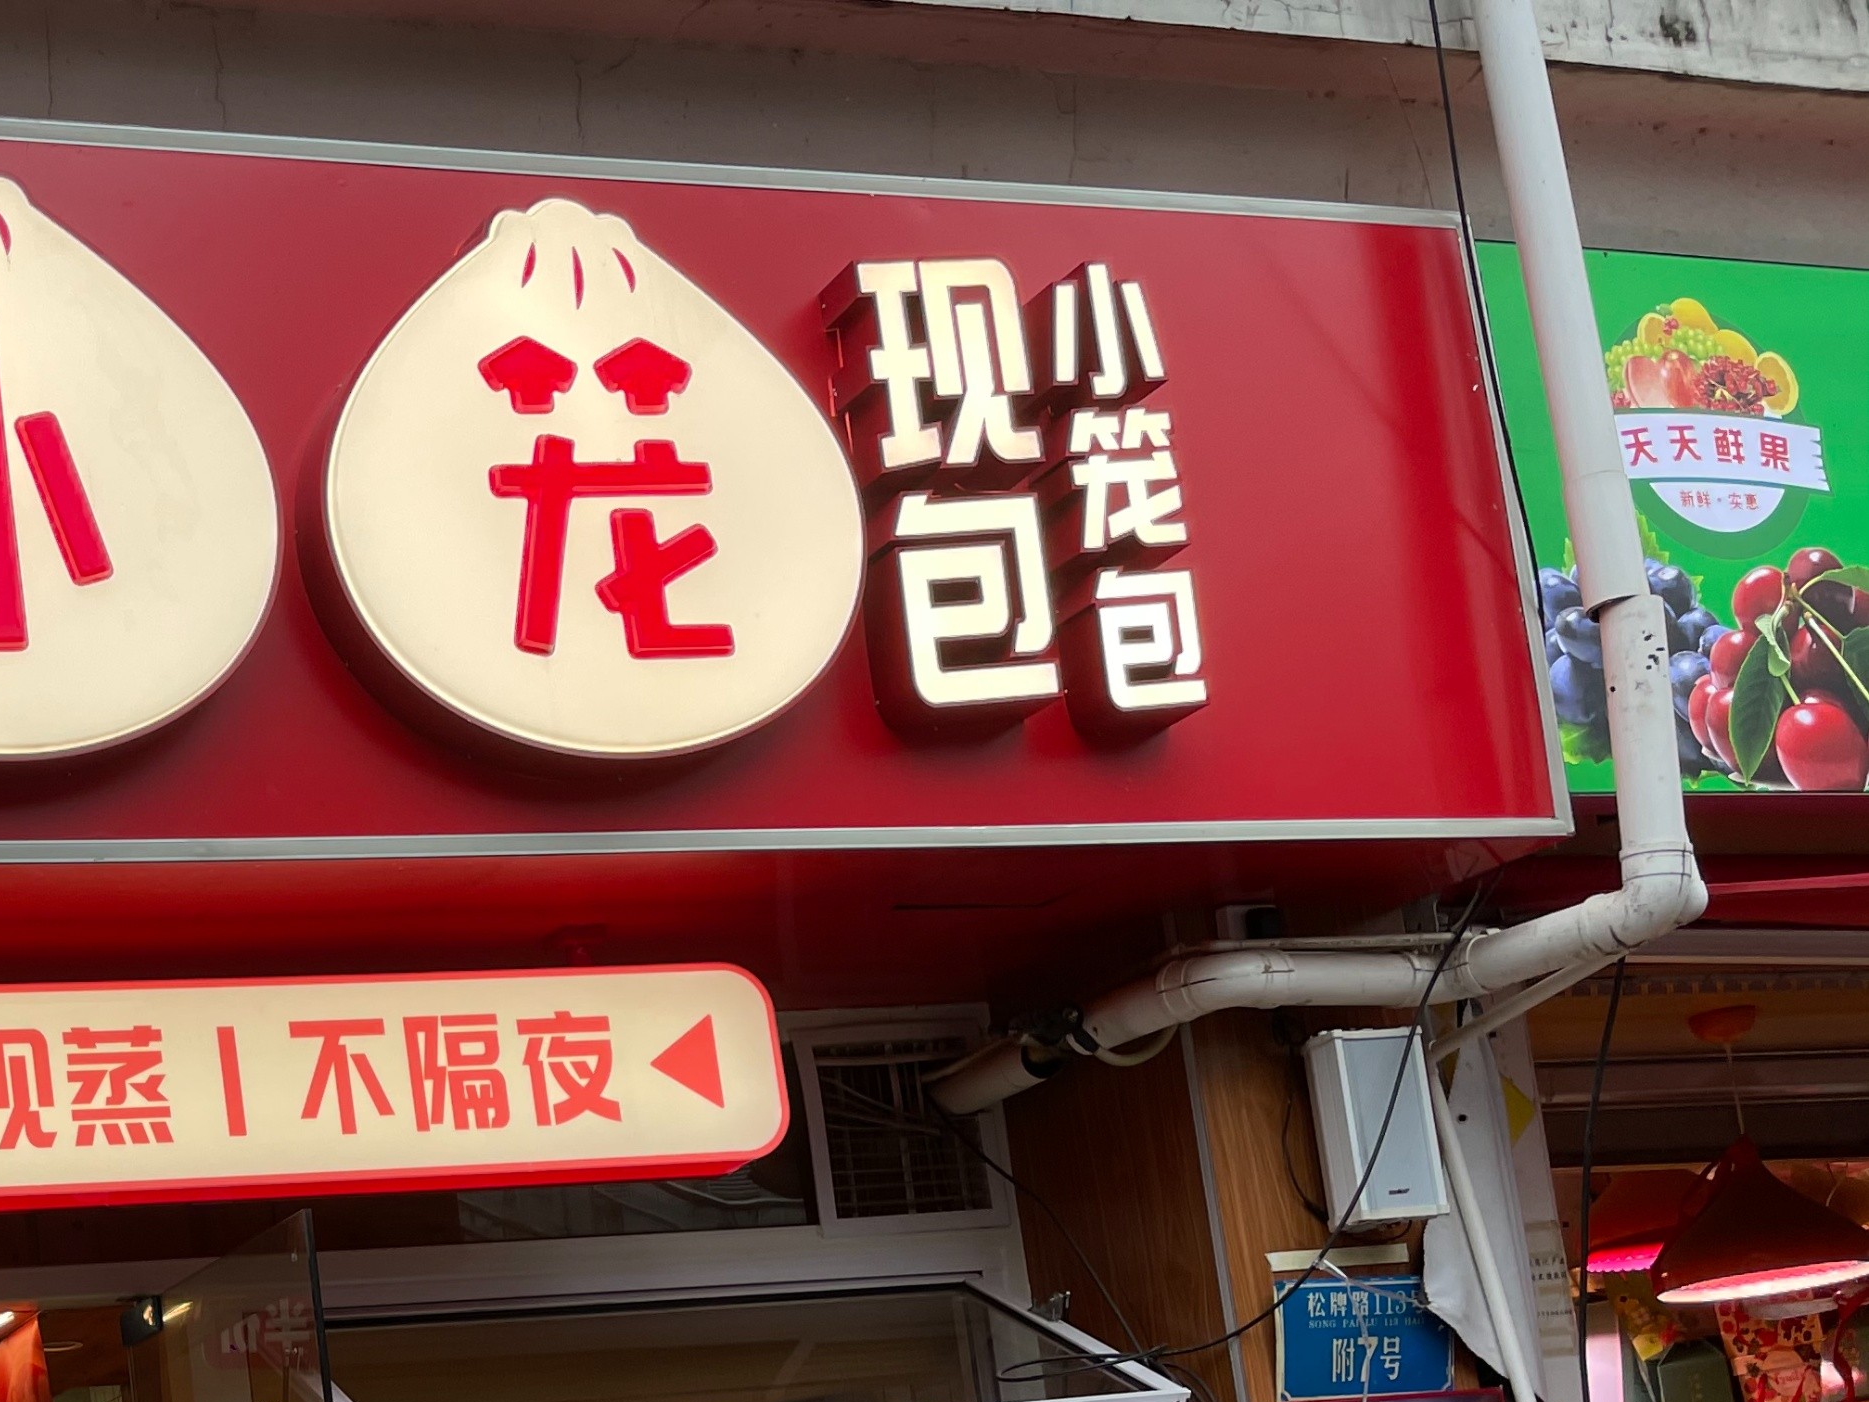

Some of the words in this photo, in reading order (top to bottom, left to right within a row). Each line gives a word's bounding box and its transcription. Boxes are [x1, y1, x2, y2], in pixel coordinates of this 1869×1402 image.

[1621, 425, 1790, 472] 天天鲜果
[1054, 262, 1208, 710] 小笼包
[1308, 1319, 1337, 1328] SONG
[1332, 1336, 1402, 1383] 附7号
